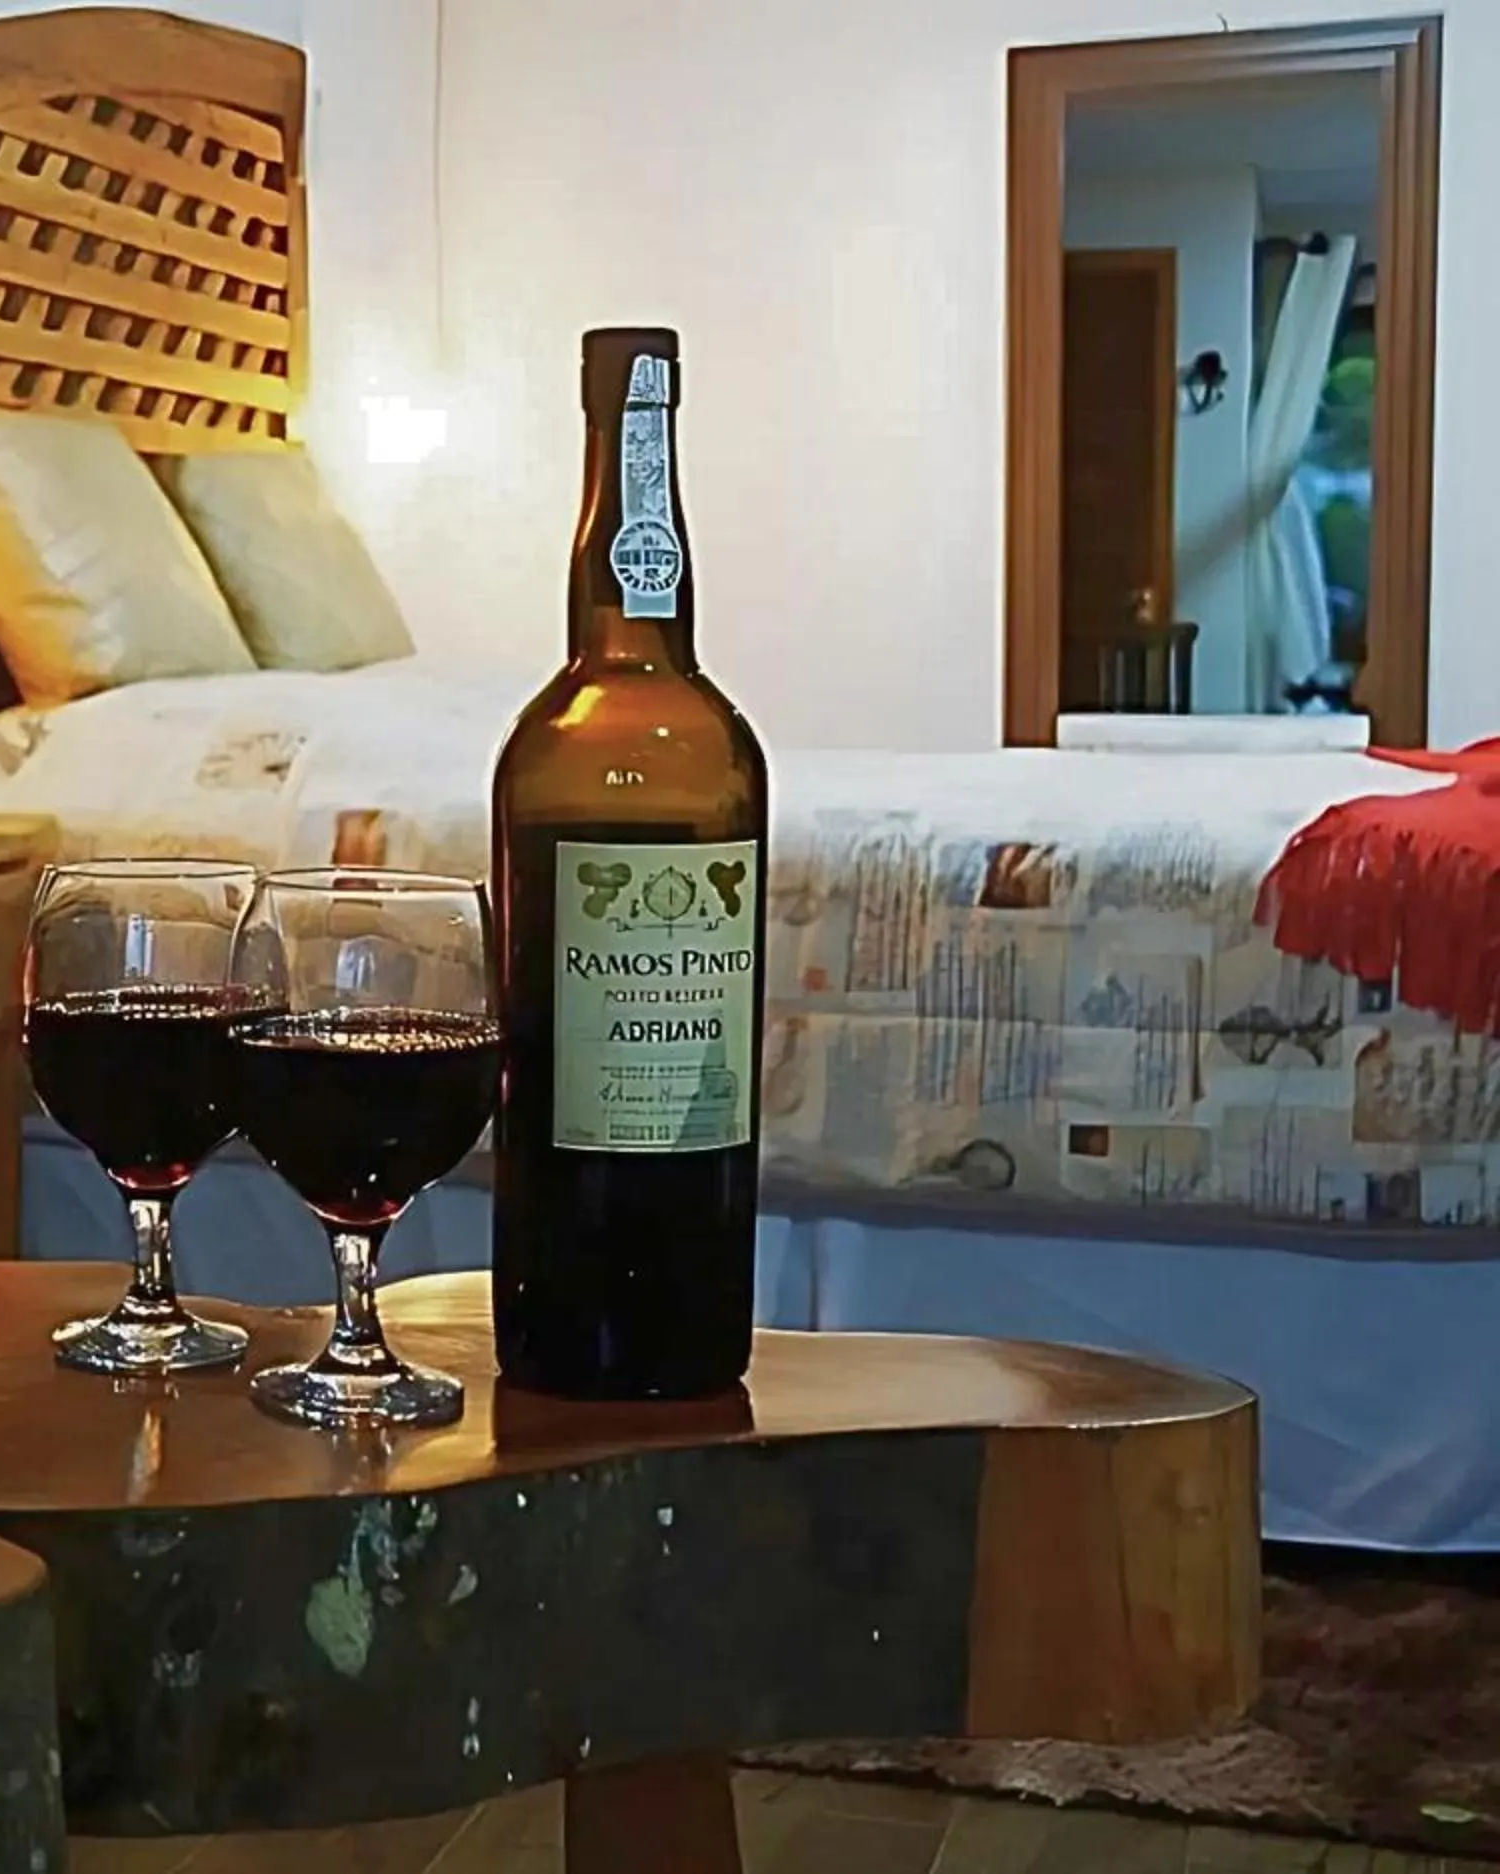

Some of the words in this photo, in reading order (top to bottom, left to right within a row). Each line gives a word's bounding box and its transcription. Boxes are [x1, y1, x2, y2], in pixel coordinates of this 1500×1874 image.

[566, 947, 673, 980] RAMOS
[681, 949, 752, 976] PINTO
[608, 1017, 723, 1043] ADRIANO
